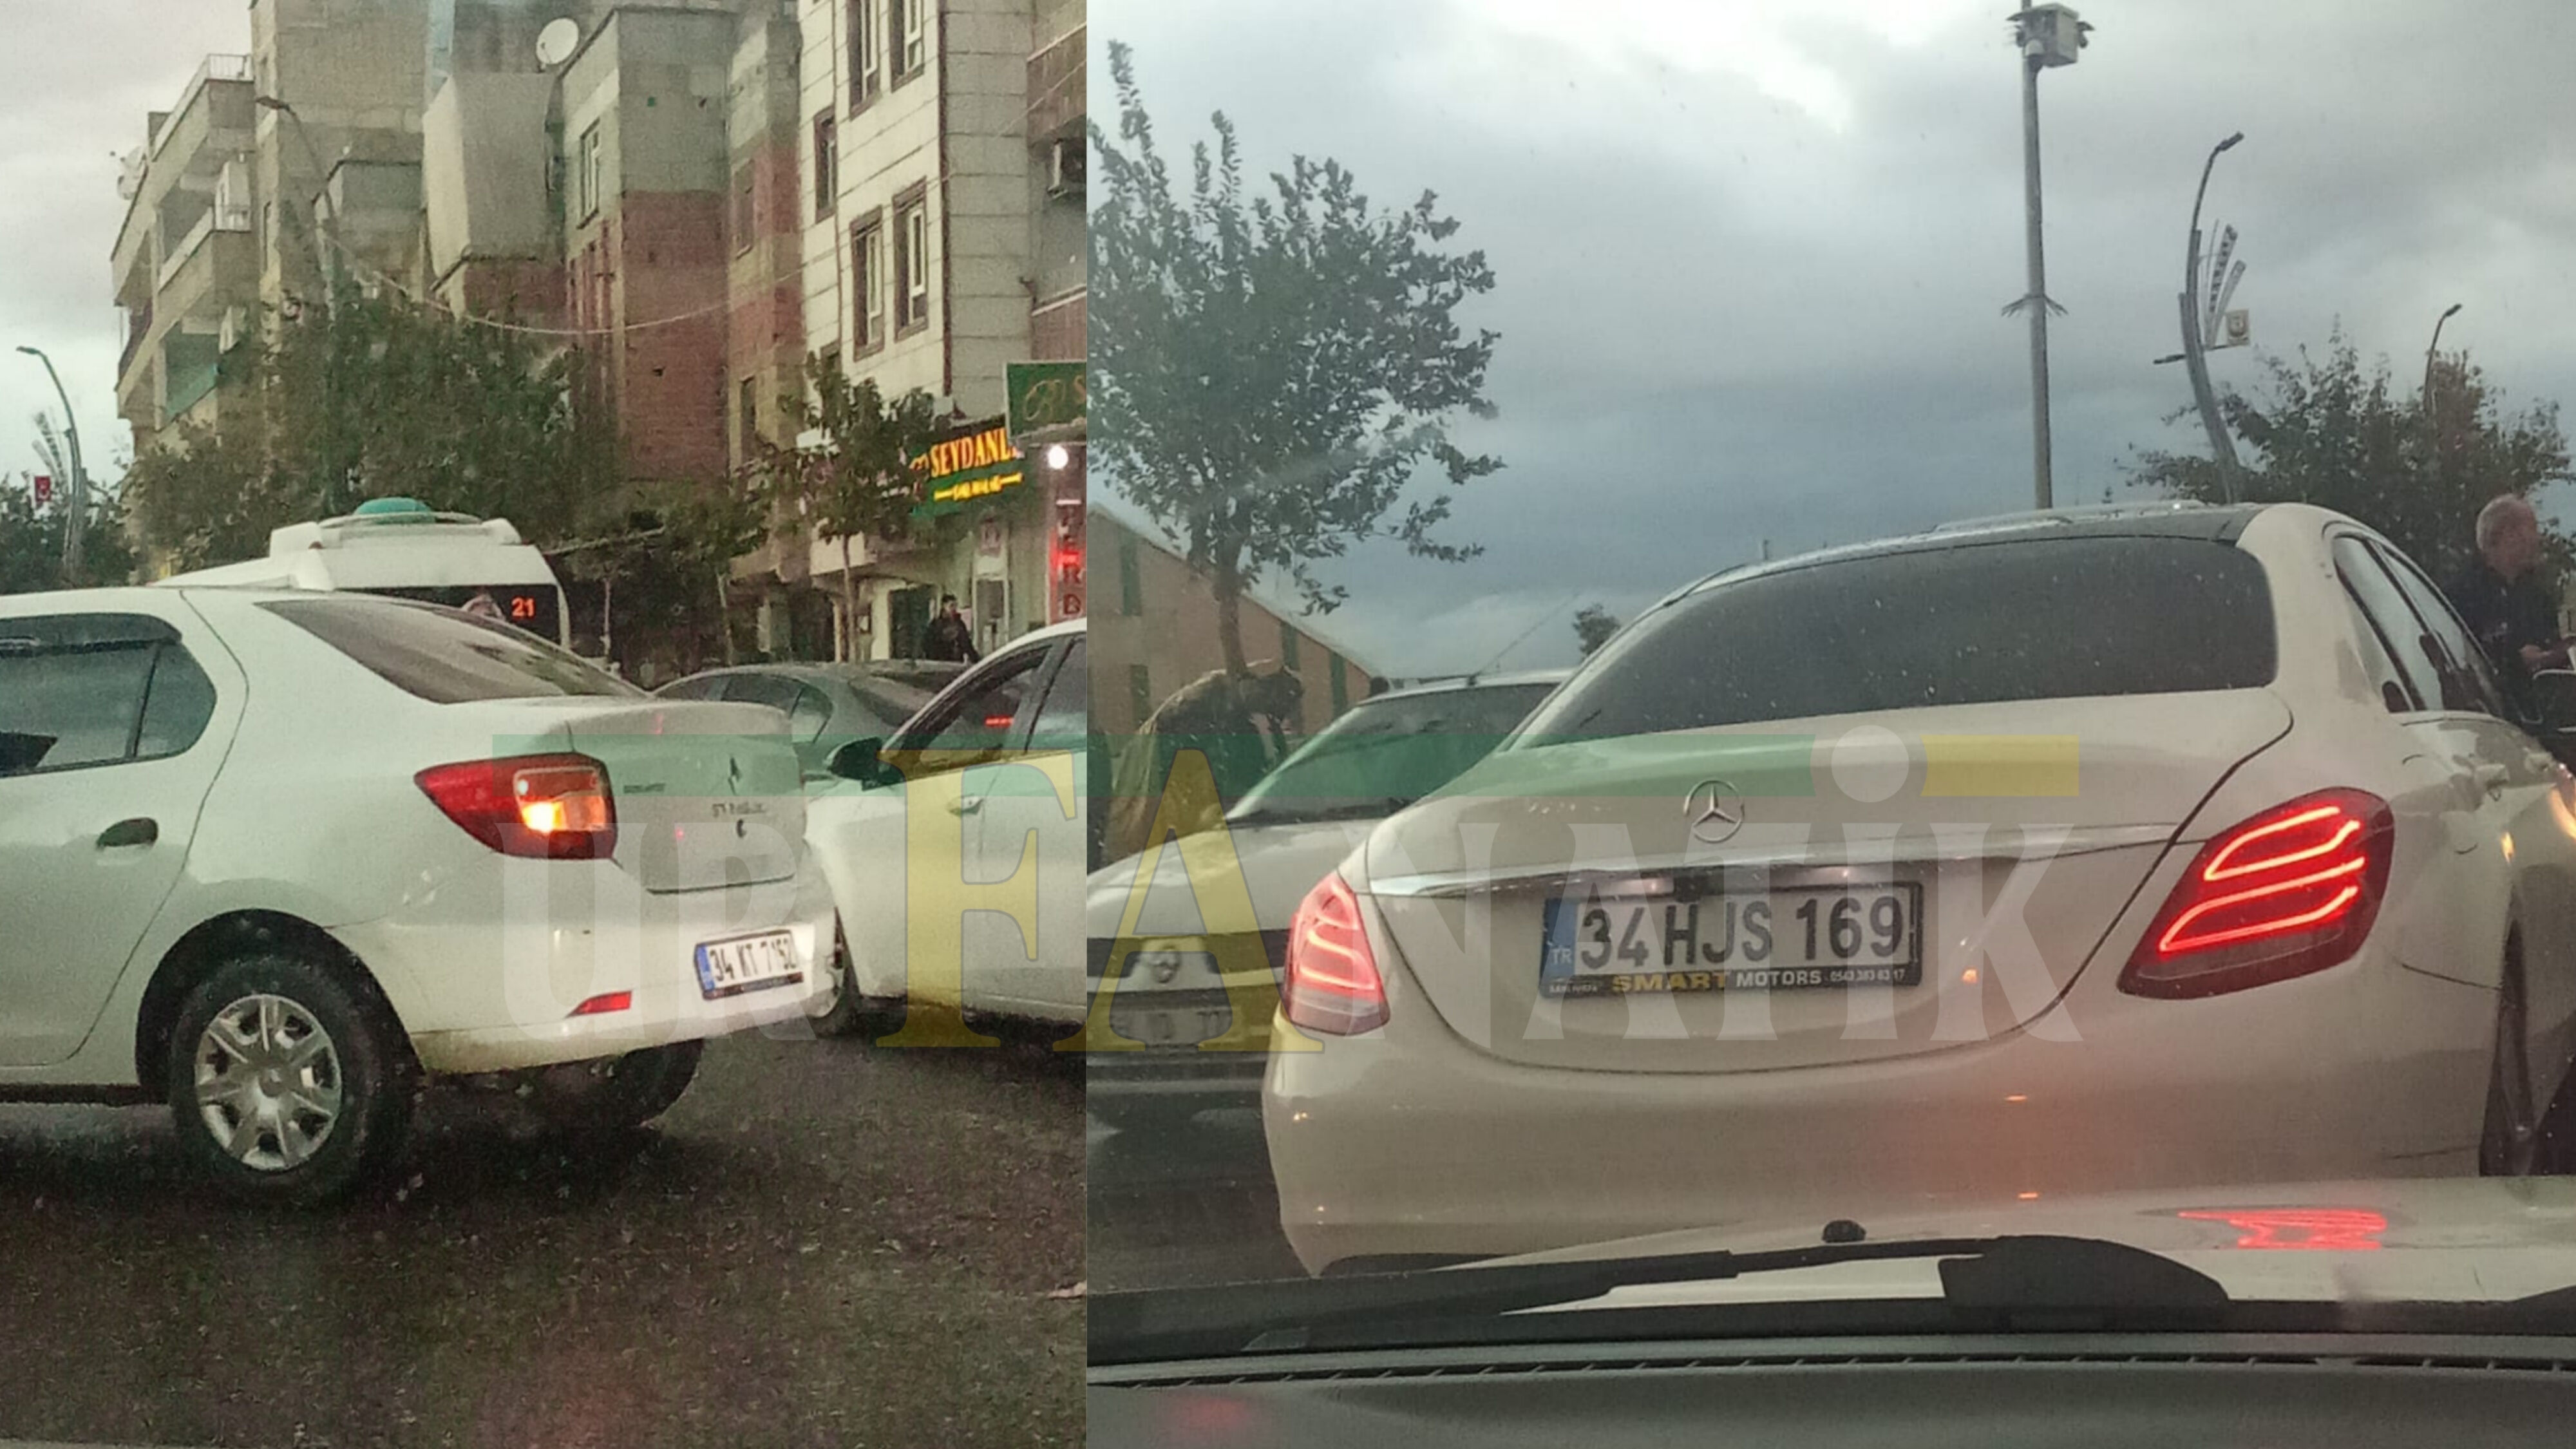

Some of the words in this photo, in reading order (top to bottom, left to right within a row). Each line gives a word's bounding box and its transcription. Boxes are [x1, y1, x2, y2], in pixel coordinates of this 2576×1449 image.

[511, 597, 535, 618] 21
[1580, 907, 1649, 969] 34
[1663, 902, 1772, 966] HJS
[1795, 895, 1904, 962] 169
[710, 948, 735, 982] 34
[1551, 948, 1571, 965] TR
[1613, 971, 1727, 992] SMART
[1736, 970, 1823, 987] MOTORS
